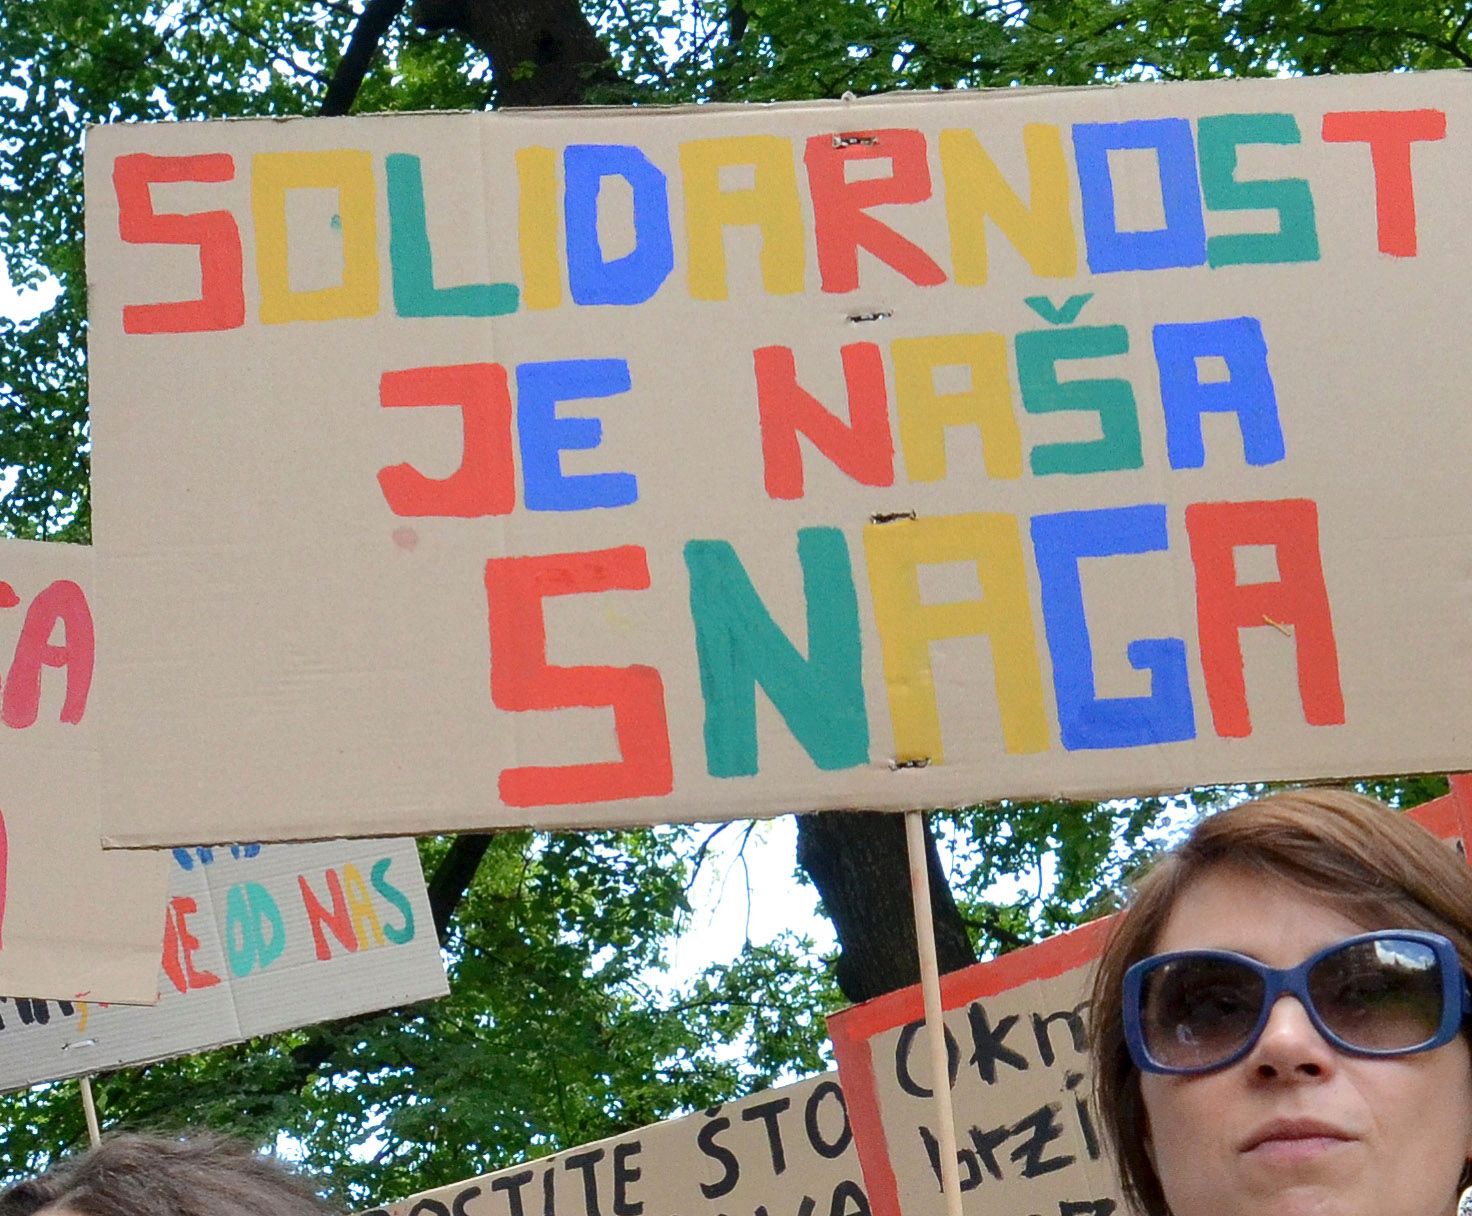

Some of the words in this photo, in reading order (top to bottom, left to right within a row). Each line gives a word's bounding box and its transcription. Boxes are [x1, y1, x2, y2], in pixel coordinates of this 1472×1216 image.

[112, 108, 1448, 335] SOLIDARNOST
[377, 358, 639, 519] JE
[754, 293, 1285, 501] NAŠA
[484, 498, 1346, 808] SNAGA
[225, 880, 286, 977] OD
[297, 856, 416, 962] NAS
[696, 1081, 854, 1198] ŠTO
